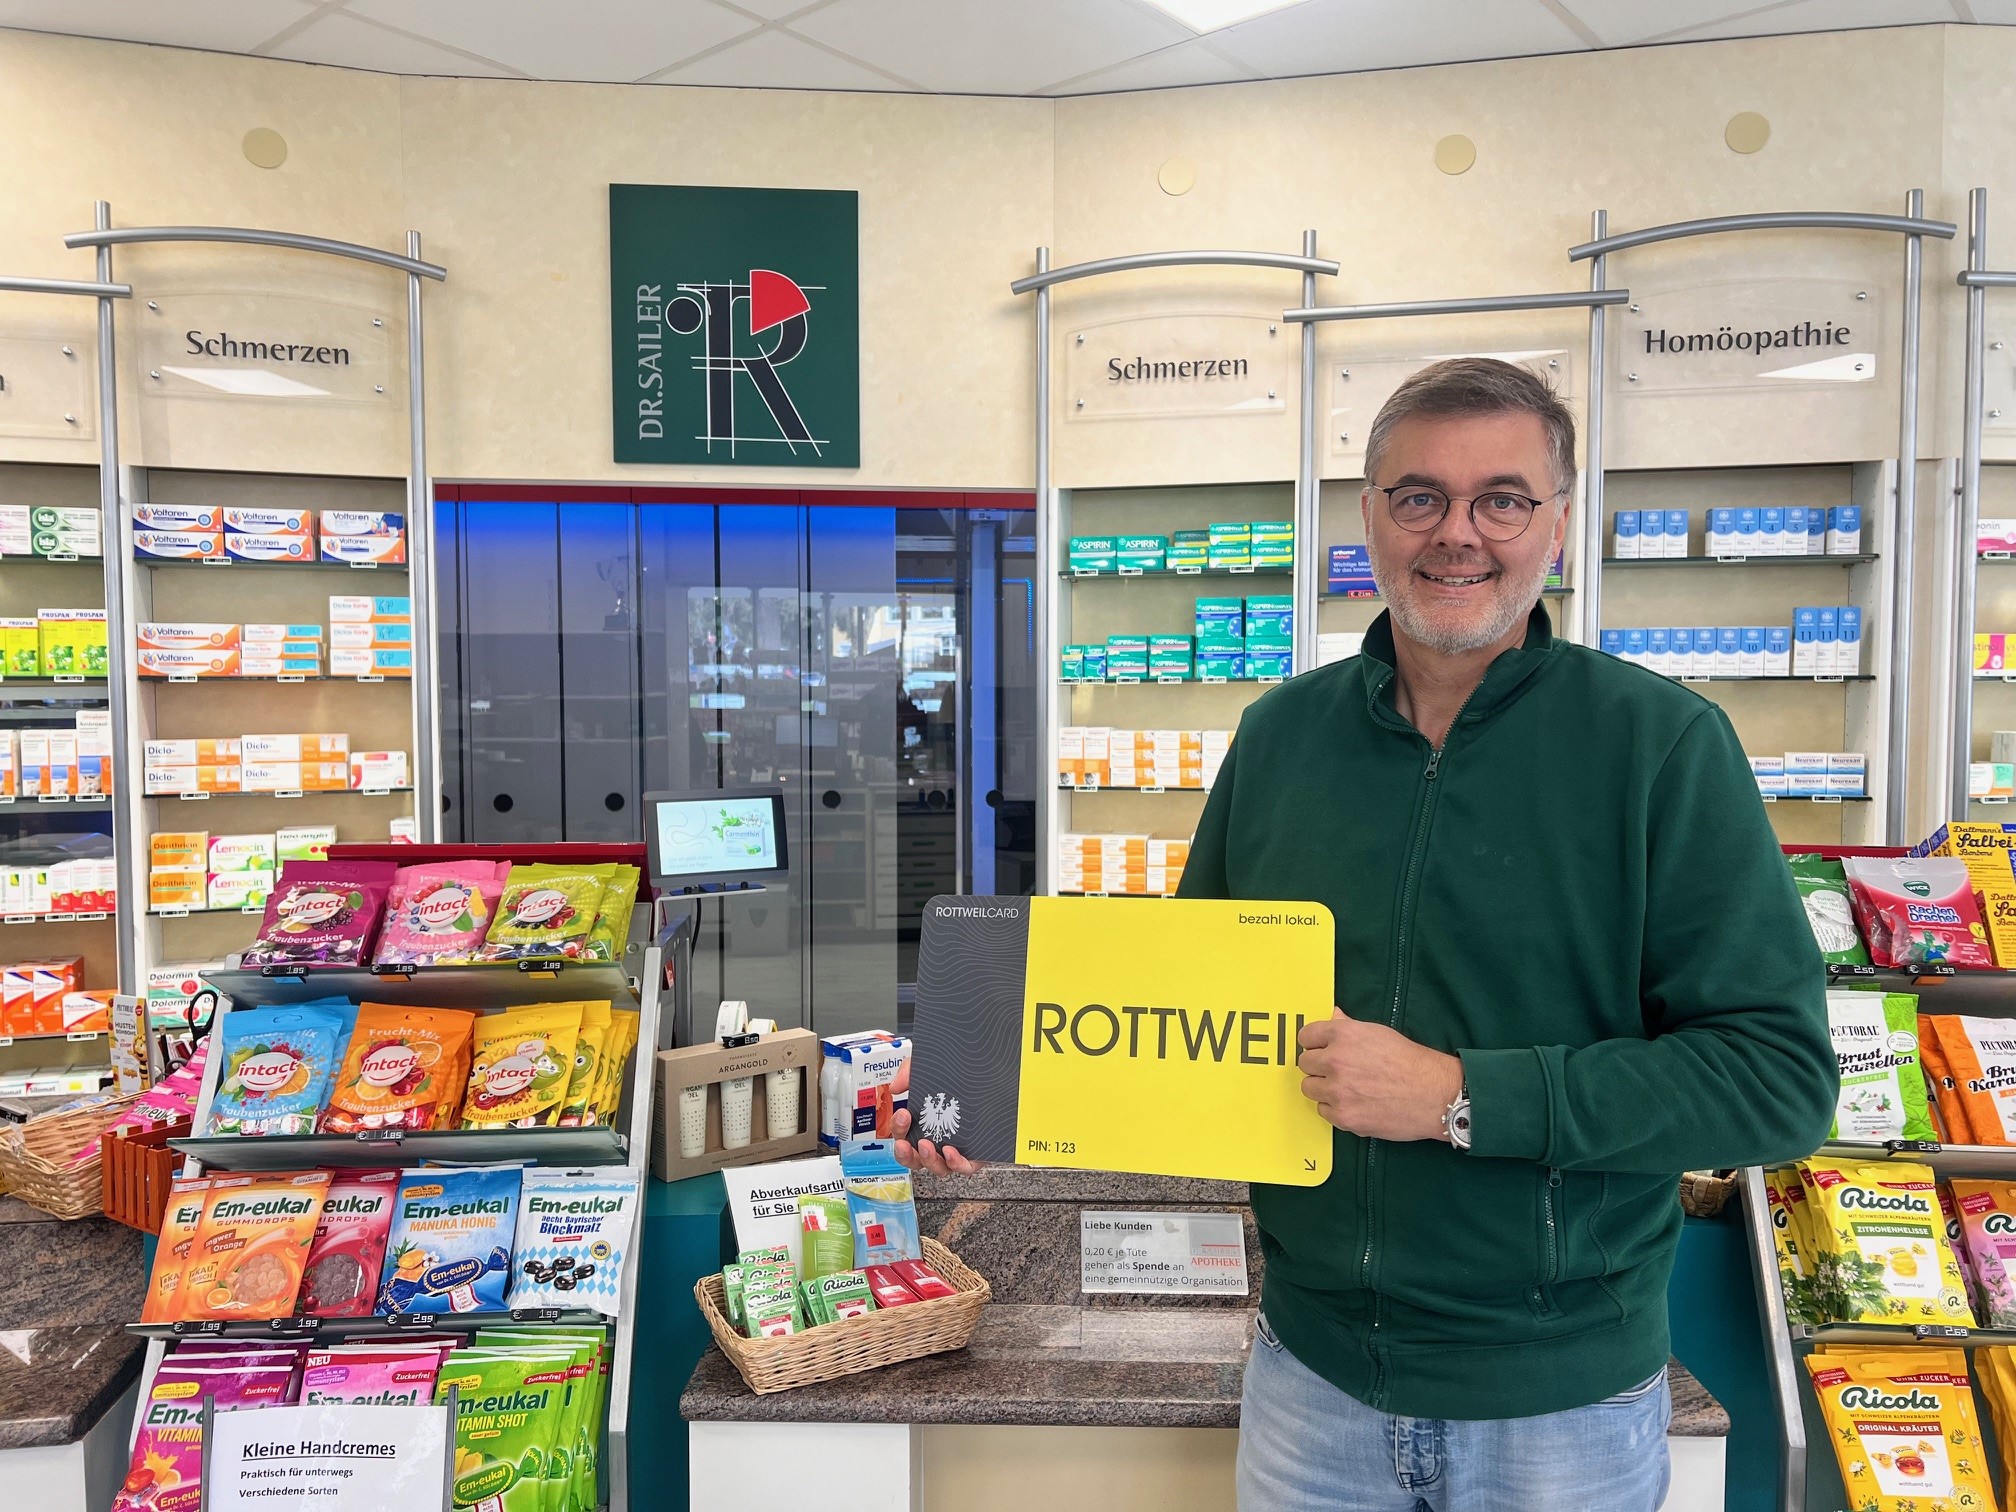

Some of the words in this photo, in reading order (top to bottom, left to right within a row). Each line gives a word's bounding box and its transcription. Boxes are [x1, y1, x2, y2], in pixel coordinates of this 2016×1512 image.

[1644, 321, 1851, 355] Homöopathie
[186, 331, 350, 365] Schmerzen
[1108, 355, 1248, 382] Schmerzen
[151, 508, 188, 518] Voltaren
[242, 512, 278, 522] Voltaren
[333, 512, 369, 522] Voltaren
[152, 535, 190, 545] Voltaren
[244, 538, 279, 548] Voltaren
[1078, 541, 1111, 550] ASPIRIN
[1125, 540, 1159, 548] ASPIRIN
[1800, 630, 1812, 640] 11
[1748, 644, 1758, 652] 10
[1772, 644, 1782, 652] 11
[1755, 760, 1782, 768] Neurexan
[216, 844, 264, 854] Lemocin
[215, 879, 263, 888] Lemocin
[1907, 884, 1929, 892] WICK
[290, 898, 344, 916] intact
[420, 897, 468, 915] intact
[517, 896, 568, 914] intact
[1908, 904, 1956, 916] Rachen
[935, 906, 1019, 920] ROTTWEILCARD
[1238, 912, 1282, 926] bezahl
[1285, 912, 1320, 926] lokal.
[1910, 912, 1960, 924] Drachen
[266, 933, 344, 944] Traubenzucker
[496, 931, 568, 942] Traubenzucker
[400, 938, 468, 951] Traubenzucker
[262, 966, 271, 974] €
[372, 964, 380, 973] €
[150, 971, 194, 981] Dolormin
[369, 1026, 442, 1041] Frucht-Mix
[1830, 1025, 1880, 1037] PECTORAL
[362, 1054, 418, 1072] intact
[1838, 1048, 1882, 1066] Brust
[239, 1058, 298, 1076] intact
[718, 1058, 768, 1074] ARGANGOLD
[864, 1058, 903, 1073] Fresubin
[1840, 1054, 1914, 1075] ramellen
[486, 1065, 538, 1083] intact
[1842, 1073, 1887, 1086] ZUCKERFREI
[221, 1102, 301, 1118] Traubenzucker
[340, 1098, 416, 1113] Traubenzucker
[466, 1106, 539, 1121] Traubenzucker
[1028, 1139, 1052, 1153] PIN:
[1054, 1141, 1076, 1154] 123
[750, 1179, 844, 1200] Abverkaufsarti
[528, 1196, 624, 1214] Em-eukal
[1840, 1188, 1930, 1212] Ricola
[213, 1197, 314, 1219] Em-eukal
[404, 1196, 510, 1219] Em-eukal
[753, 1206, 770, 1216] für
[774, 1203, 794, 1214] Sie
[216, 1216, 295, 1226] GUMMIDROPS
[410, 1219, 458, 1232] MANUKA
[460, 1216, 497, 1230] HONIG
[564, 1216, 604, 1224] Bayrischer
[1085, 1221, 1112, 1230] Liebe
[1114, 1222, 1152, 1231] Kunden
[540, 1222, 602, 1236] Blockmalz
[1856, 1225, 1930, 1235] ZITRONENMELISSE
[206, 1231, 233, 1248] Ingwer
[213, 1240, 244, 1253] Orange
[1084, 1248, 1104, 1257] 0,20
[1107, 1248, 1113, 1256] €
[1115, 1248, 1124, 1259] je
[1126, 1248, 1147, 1257] Tüte
[1084, 1262, 1114, 1272] gehen
[1116, 1261, 1130, 1270] als
[1132, 1262, 1170, 1272] Spende
[1190, 1257, 1242, 1267] APOTHEKE
[430, 1261, 475, 1282] Em-eukal
[824, 1276, 864, 1292] Ricola
[1085, 1275, 1106, 1284] eine
[1108, 1276, 1178, 1286] gemeinnützige
[1181, 1276, 1243, 1288] Organisation
[271, 1319, 281, 1328] €
[387, 1314, 398, 1324] €
[412, 1314, 434, 1324] 2.99
[174, 1322, 183, 1332] €
[307, 1355, 332, 1367] NEU
[396, 1372, 430, 1380] Zuckerfrei
[527, 1374, 562, 1384] Zuckerfrei
[1920, 1374, 1950, 1382] ZUCKER
[245, 1386, 280, 1395] Zuckerfrei
[1842, 1386, 1940, 1410] Ricola
[456, 1415, 494, 1432] ITAMIN
[496, 1413, 528, 1428] SHOT
[1858, 1424, 1899, 1432] ORIGINAL
[1900, 1422, 1940, 1432] KRÄUTER
[243, 1442, 296, 1458] Kleine
[300, 1440, 396, 1456] Handcremes
[240, 1468, 286, 1480] Praktisch
[289, 1468, 303, 1477] für
[306, 1468, 354, 1478] unterwegs
[460, 1469, 506, 1494] Em-eukal
[240, 1487, 305, 1498] Verschiedene
[308, 1486, 338, 1496] Sorten
